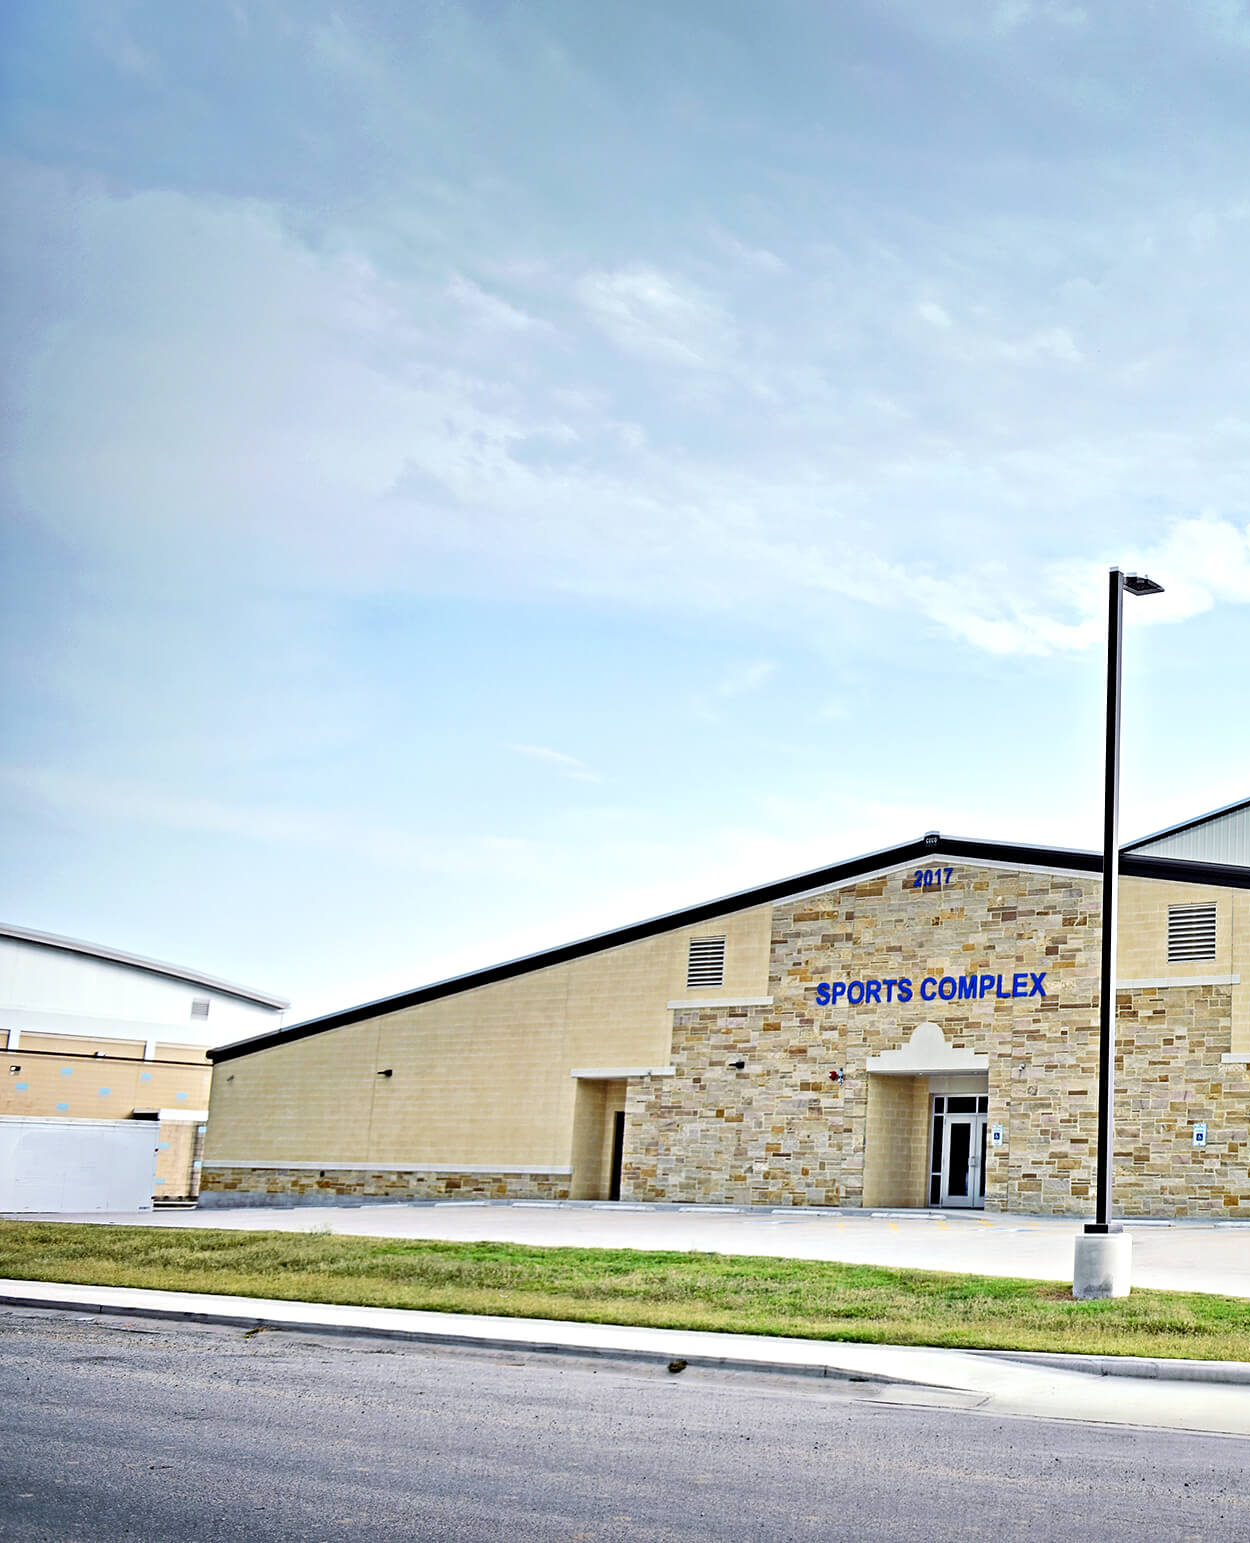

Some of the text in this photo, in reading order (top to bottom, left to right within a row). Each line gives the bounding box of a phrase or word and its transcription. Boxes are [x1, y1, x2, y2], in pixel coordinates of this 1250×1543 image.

[913, 867, 953, 887] 2017
[816, 972, 1047, 1006] SPORTS COMPLEX
